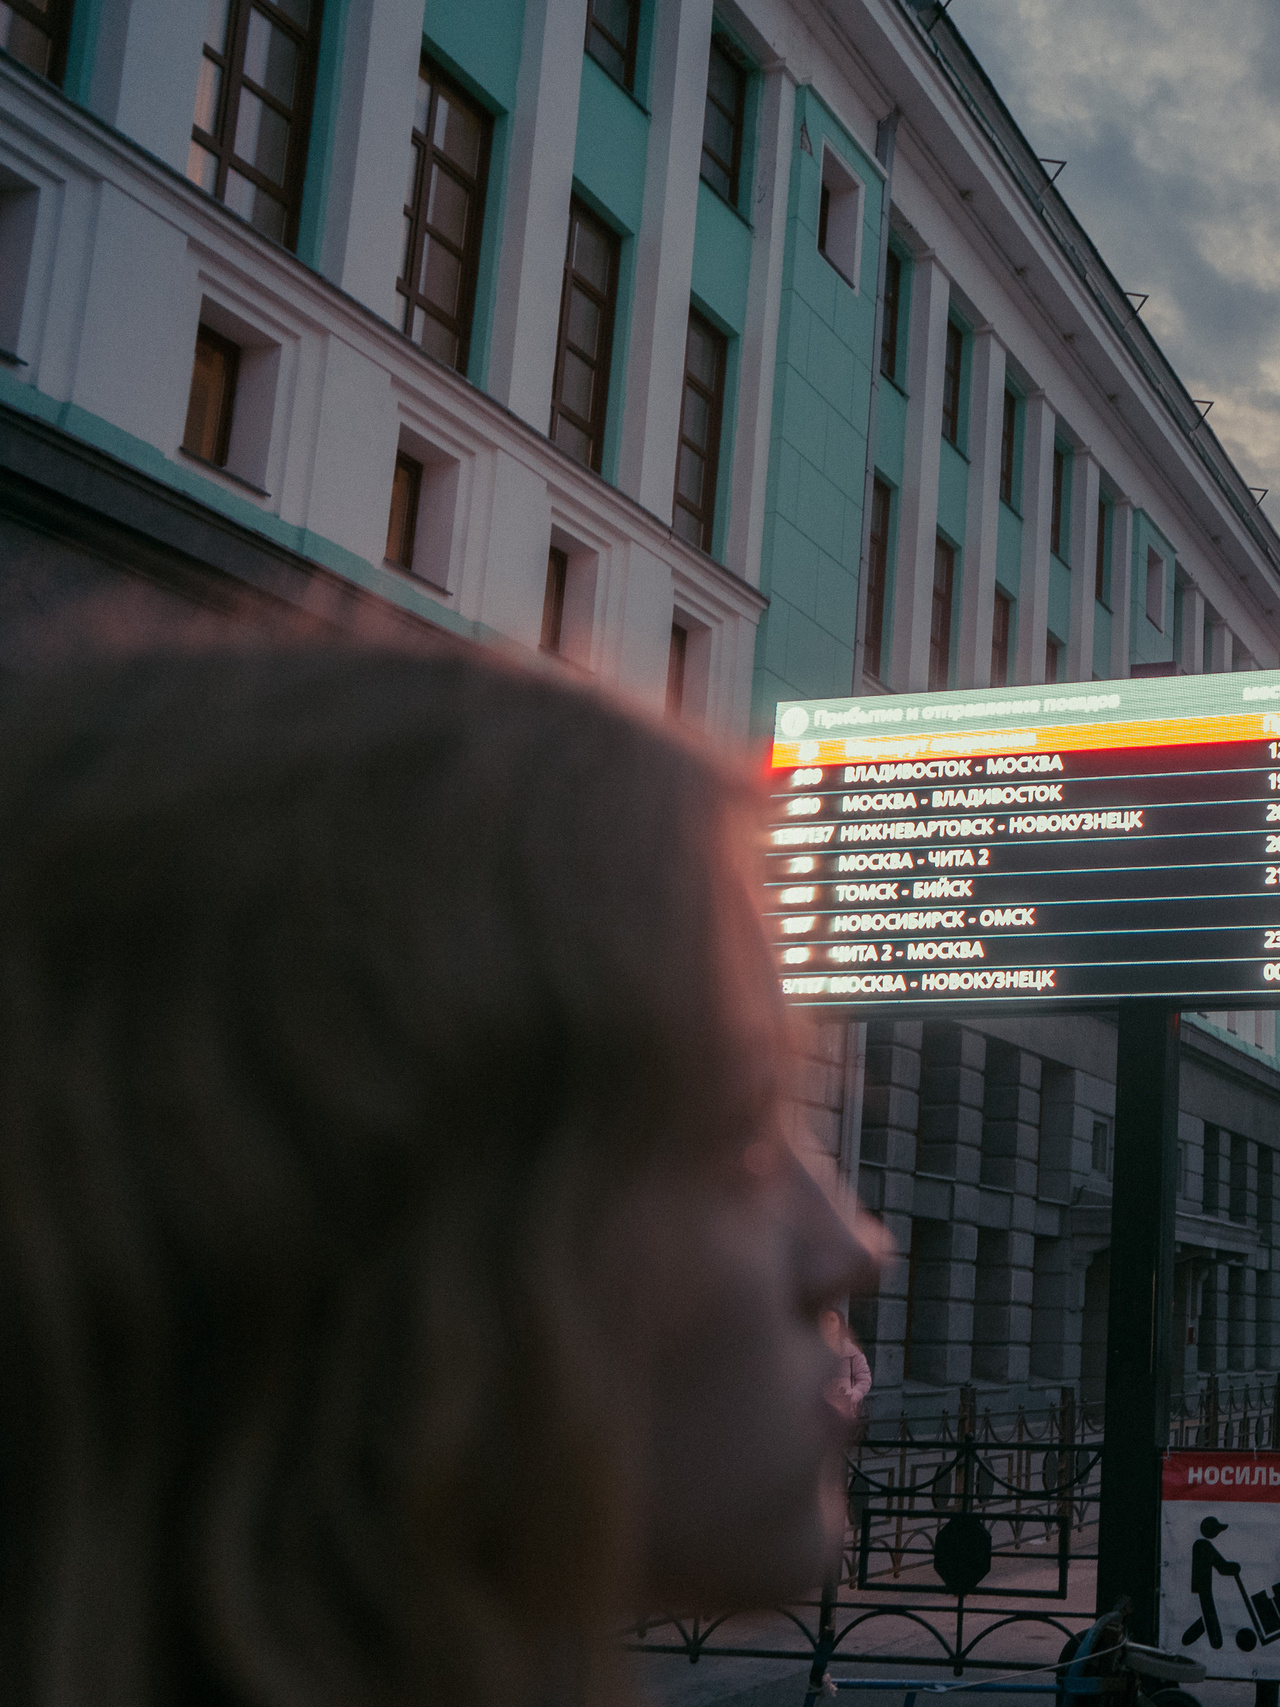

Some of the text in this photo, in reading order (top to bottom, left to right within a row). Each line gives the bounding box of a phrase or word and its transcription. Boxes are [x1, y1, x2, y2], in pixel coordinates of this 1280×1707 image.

[814, 694, 1121, 727] Прибытие и отправление поездов
[844, 760, 971, 783] ВЛАДИВОСТОК
[987, 755, 1063, 774] МОСКВА
[842, 793, 916, 812] МОСКВА
[930, 784, 1062, 808] ВЛАДИВОСТОК
[840, 816, 993, 842] НИЖНЕВАРТОВСК
[1007, 811, 1142, 833] НОВОКУЗНЕЦК
[838, 853, 913, 872] МОСКВА
[928, 850, 974, 867] ЧИТА
[978, 849, 988, 865] 2
[835, 883, 897, 902] ТОМСК
[911, 875, 973, 898] БИЙСК
[832, 911, 964, 932] НОВОСИБИРСК
[980, 908, 1034, 926] ОМСК
[827, 945, 877, 963] ЧИТА
[881, 945, 891, 961] 2
[907, 941, 983, 960] МОСКВА
[829, 975, 906, 993] МОСКВА
[922, 970, 1054, 990] НОВОКУЗНЕЦК
